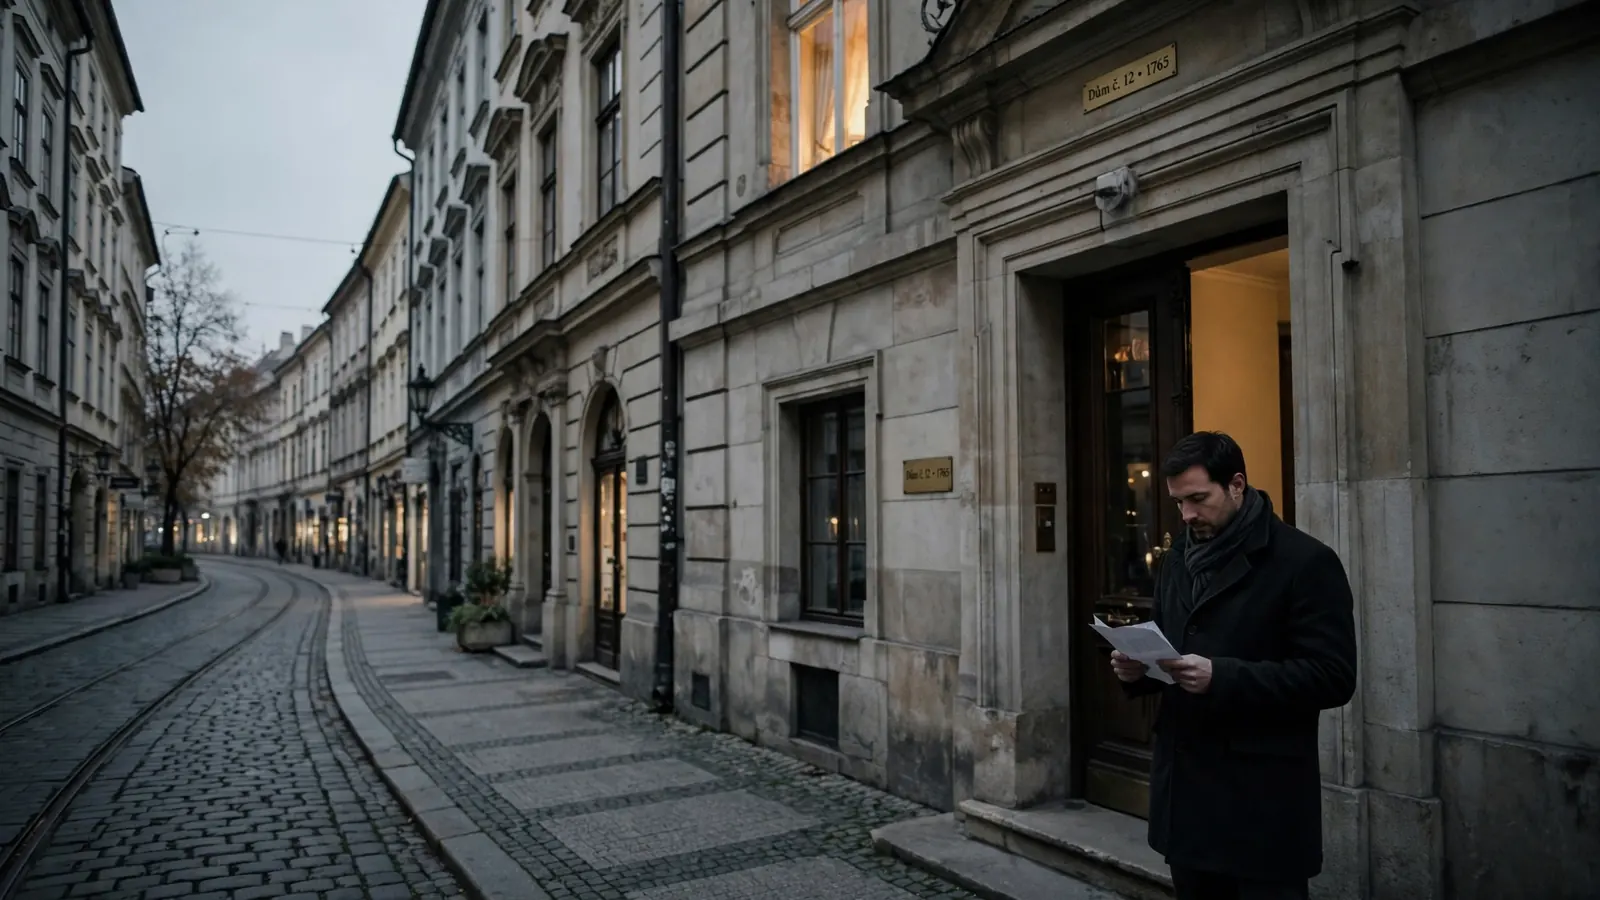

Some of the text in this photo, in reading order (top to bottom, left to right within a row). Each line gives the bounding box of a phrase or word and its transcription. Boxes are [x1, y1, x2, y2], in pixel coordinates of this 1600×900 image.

[1088, 55, 1169, 101] Dům č. 12 1765
